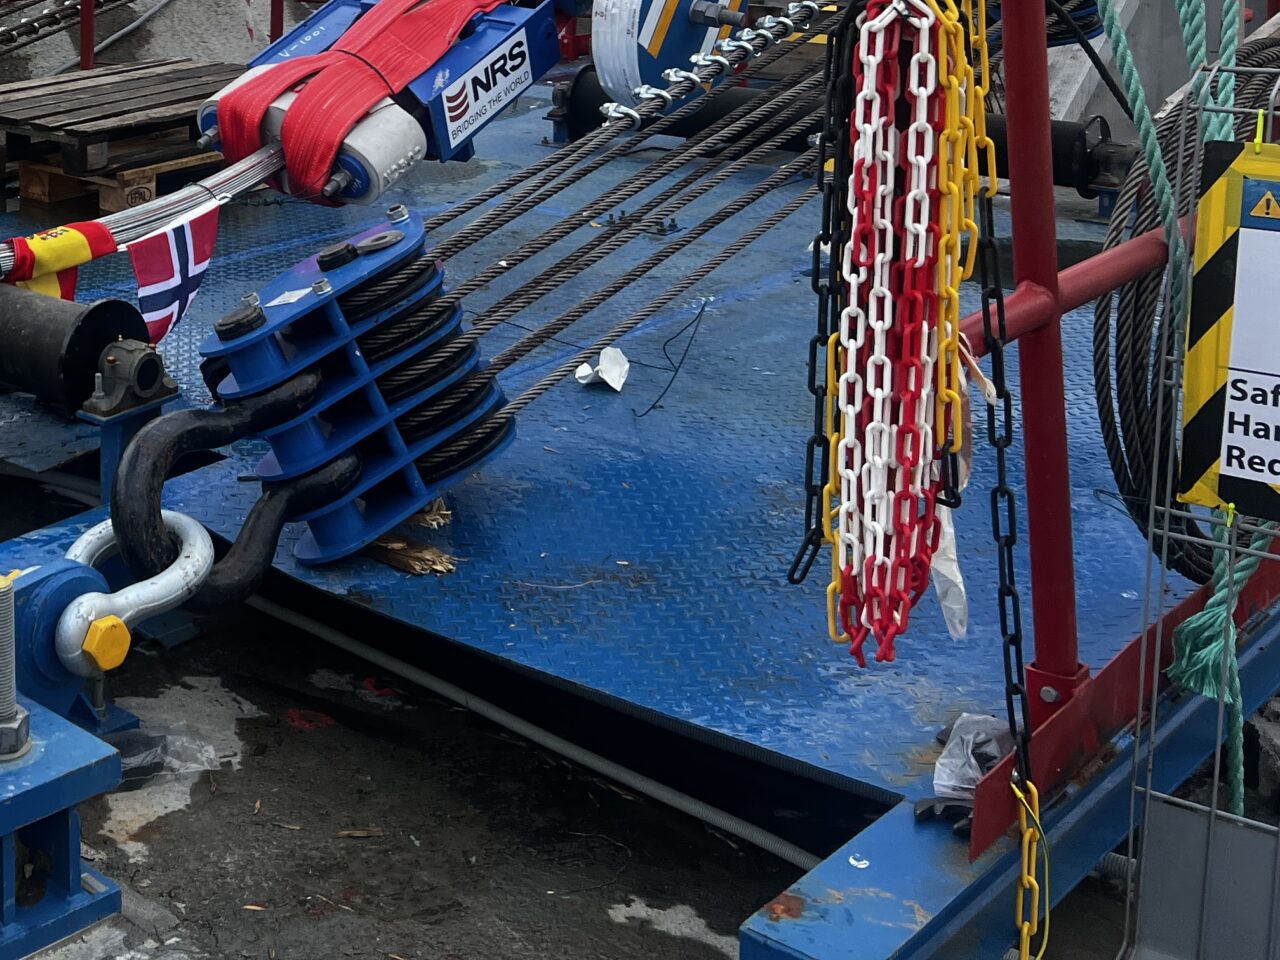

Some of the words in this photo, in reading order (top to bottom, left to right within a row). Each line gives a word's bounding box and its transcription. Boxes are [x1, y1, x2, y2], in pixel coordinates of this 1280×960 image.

[471, 40, 527, 103] NRS
[451, 104, 488, 140] BRIDGING
[488, 92, 503, 110] THE
[503, 70, 530, 97] WORLD
